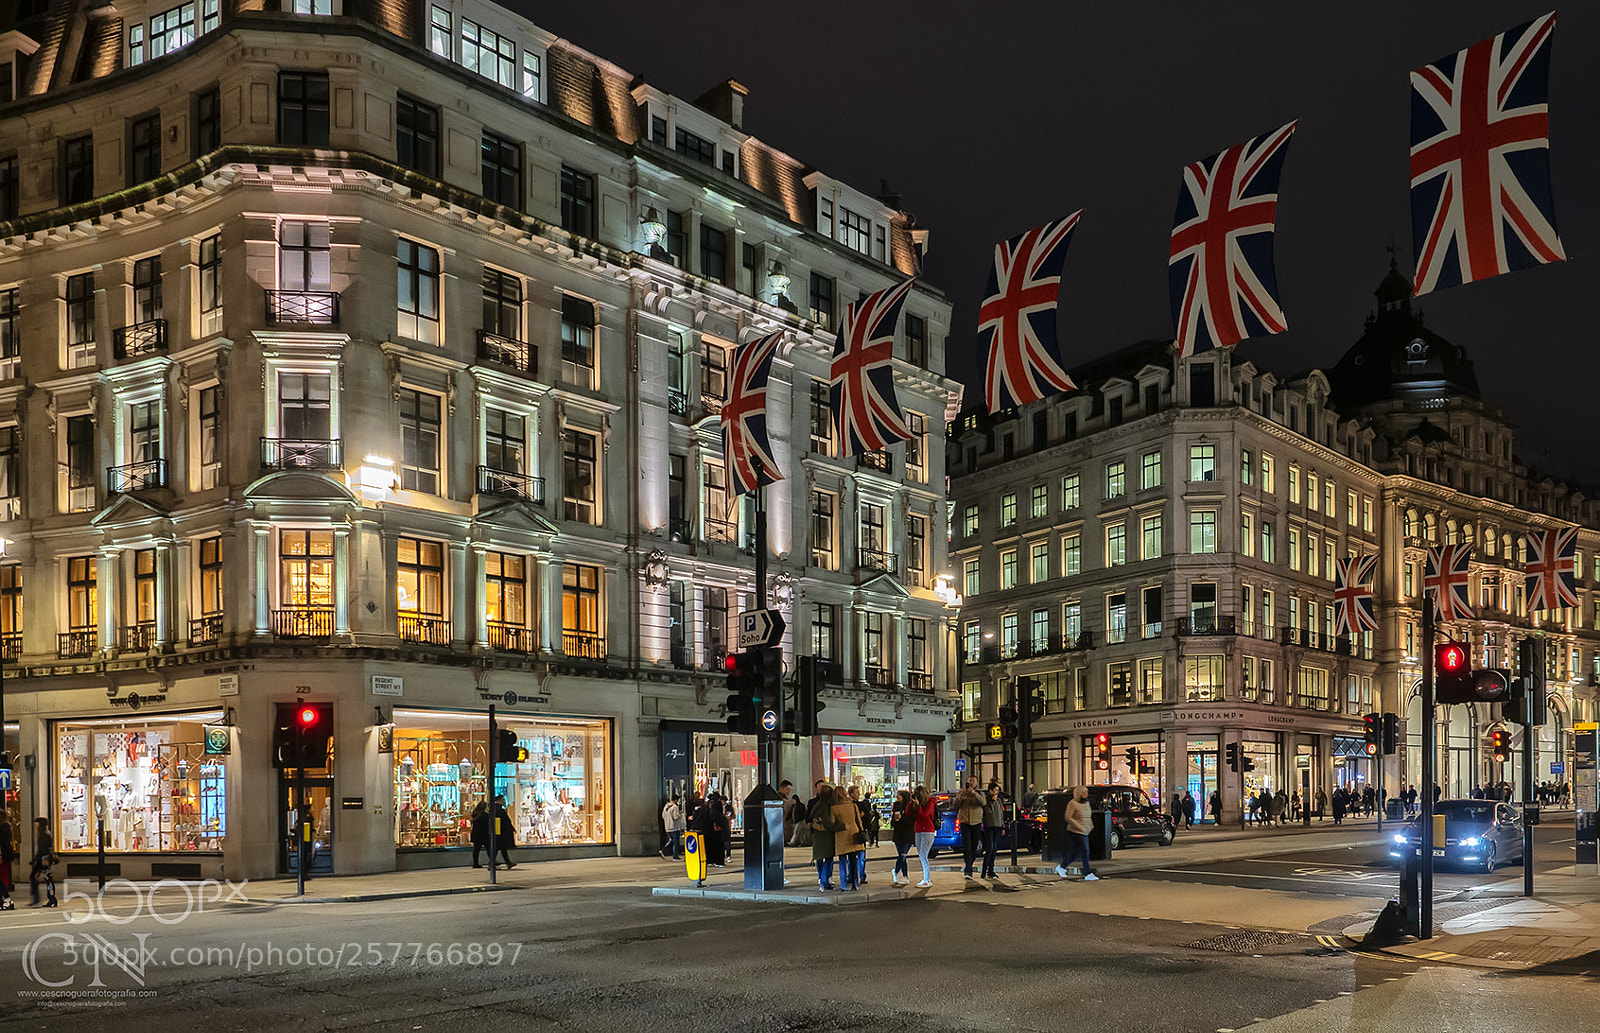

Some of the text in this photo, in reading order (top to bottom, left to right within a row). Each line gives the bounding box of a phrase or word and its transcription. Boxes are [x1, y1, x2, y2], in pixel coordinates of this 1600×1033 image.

[746, 616, 754, 631] P
[741, 634, 760, 644] Soho
[295, 685, 311, 694] 223
[480, 692, 504, 701] TORY
[1175, 712, 1237, 721] LONGCHAMP
[1267, 715, 1295, 724] LONGCHAMP
[1073, 718, 1118, 729] LONGCHAMP
